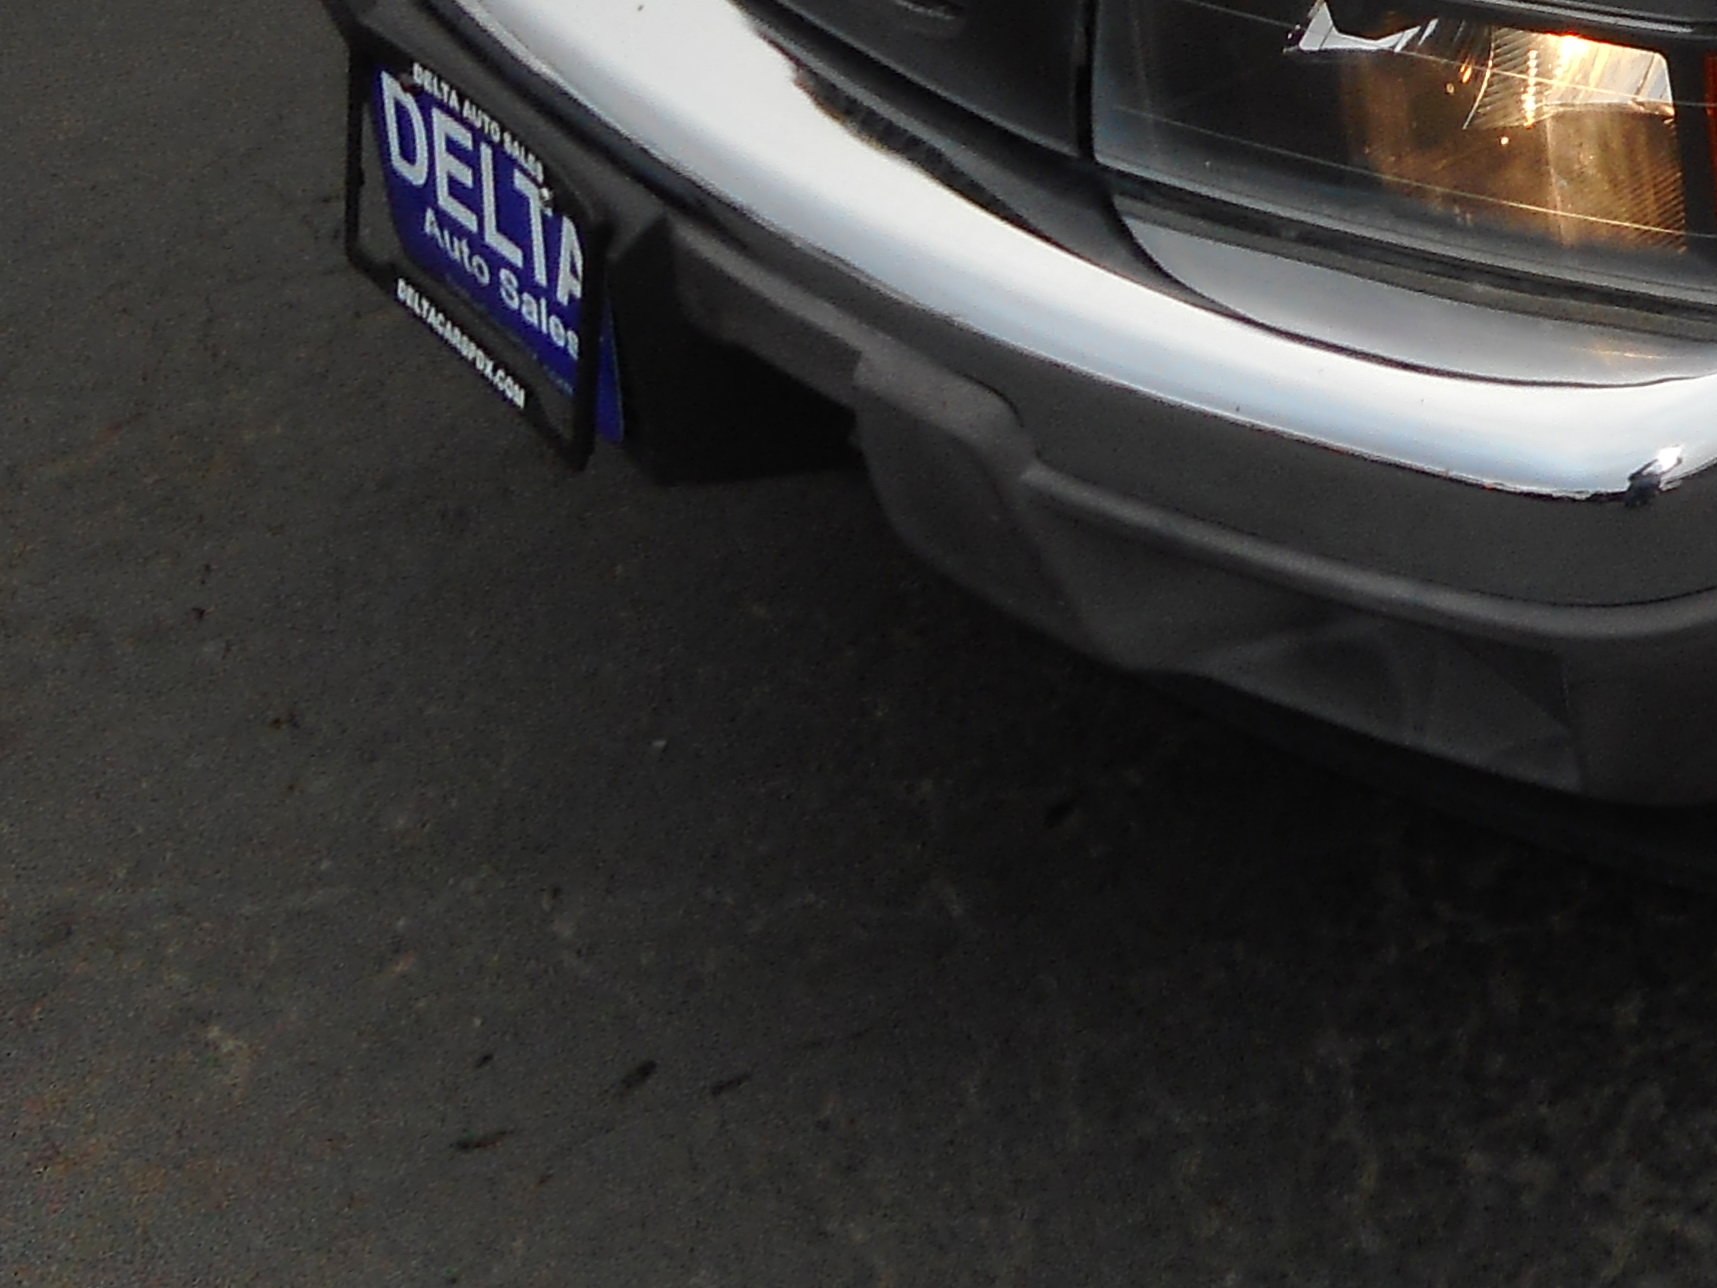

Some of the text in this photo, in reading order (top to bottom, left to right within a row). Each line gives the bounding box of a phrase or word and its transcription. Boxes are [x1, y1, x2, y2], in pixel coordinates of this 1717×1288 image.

[413, 62, 460, 113] DELTA
[462, 99, 501, 143] AUTO
[380, 70, 583, 306] DELTA
[424, 207, 579, 360] Auto Sales
